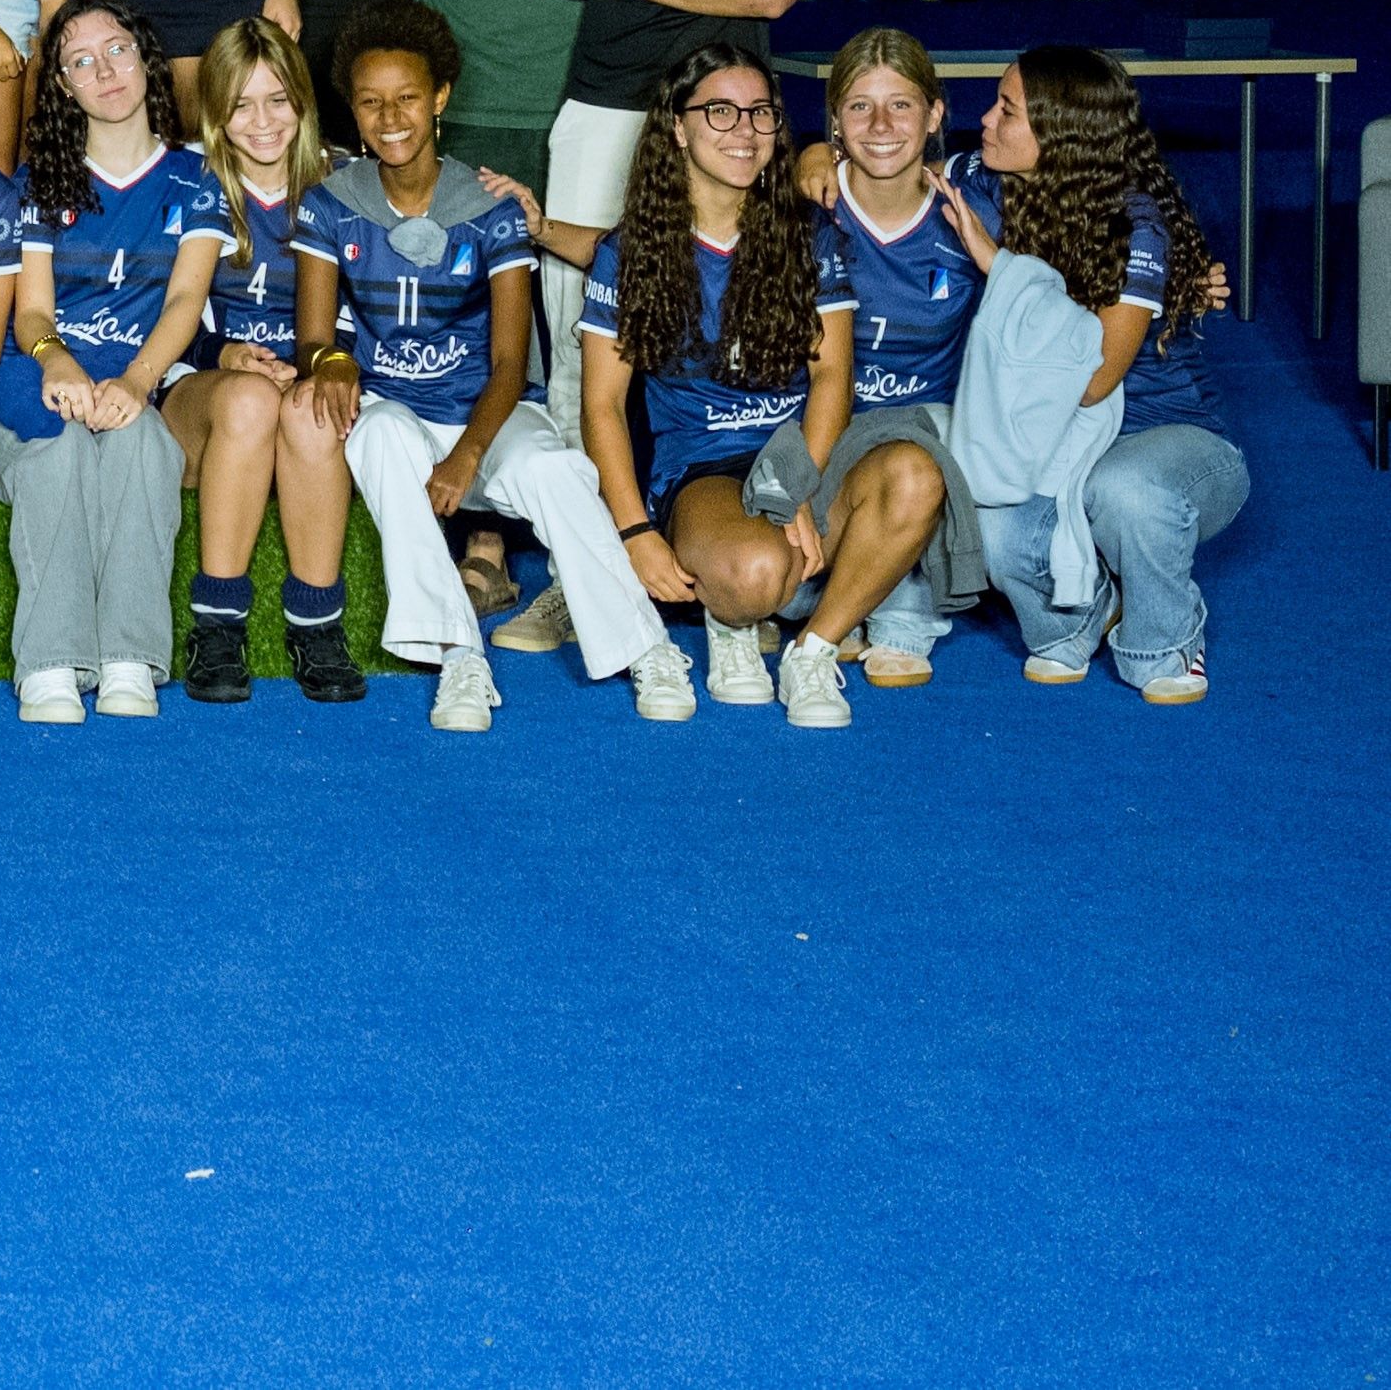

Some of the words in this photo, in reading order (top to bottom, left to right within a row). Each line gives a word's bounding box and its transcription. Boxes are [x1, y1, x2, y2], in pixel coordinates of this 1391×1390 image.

[107, 248, 126, 291] 4
[246, 262, 268, 305] 4
[396, 276, 419, 327] 11
[253, 321, 297, 343] Cuba
[870, 316, 888, 351] 7
[372, 341, 421, 376] Enjoy
[421, 336, 469, 372] Cuba
